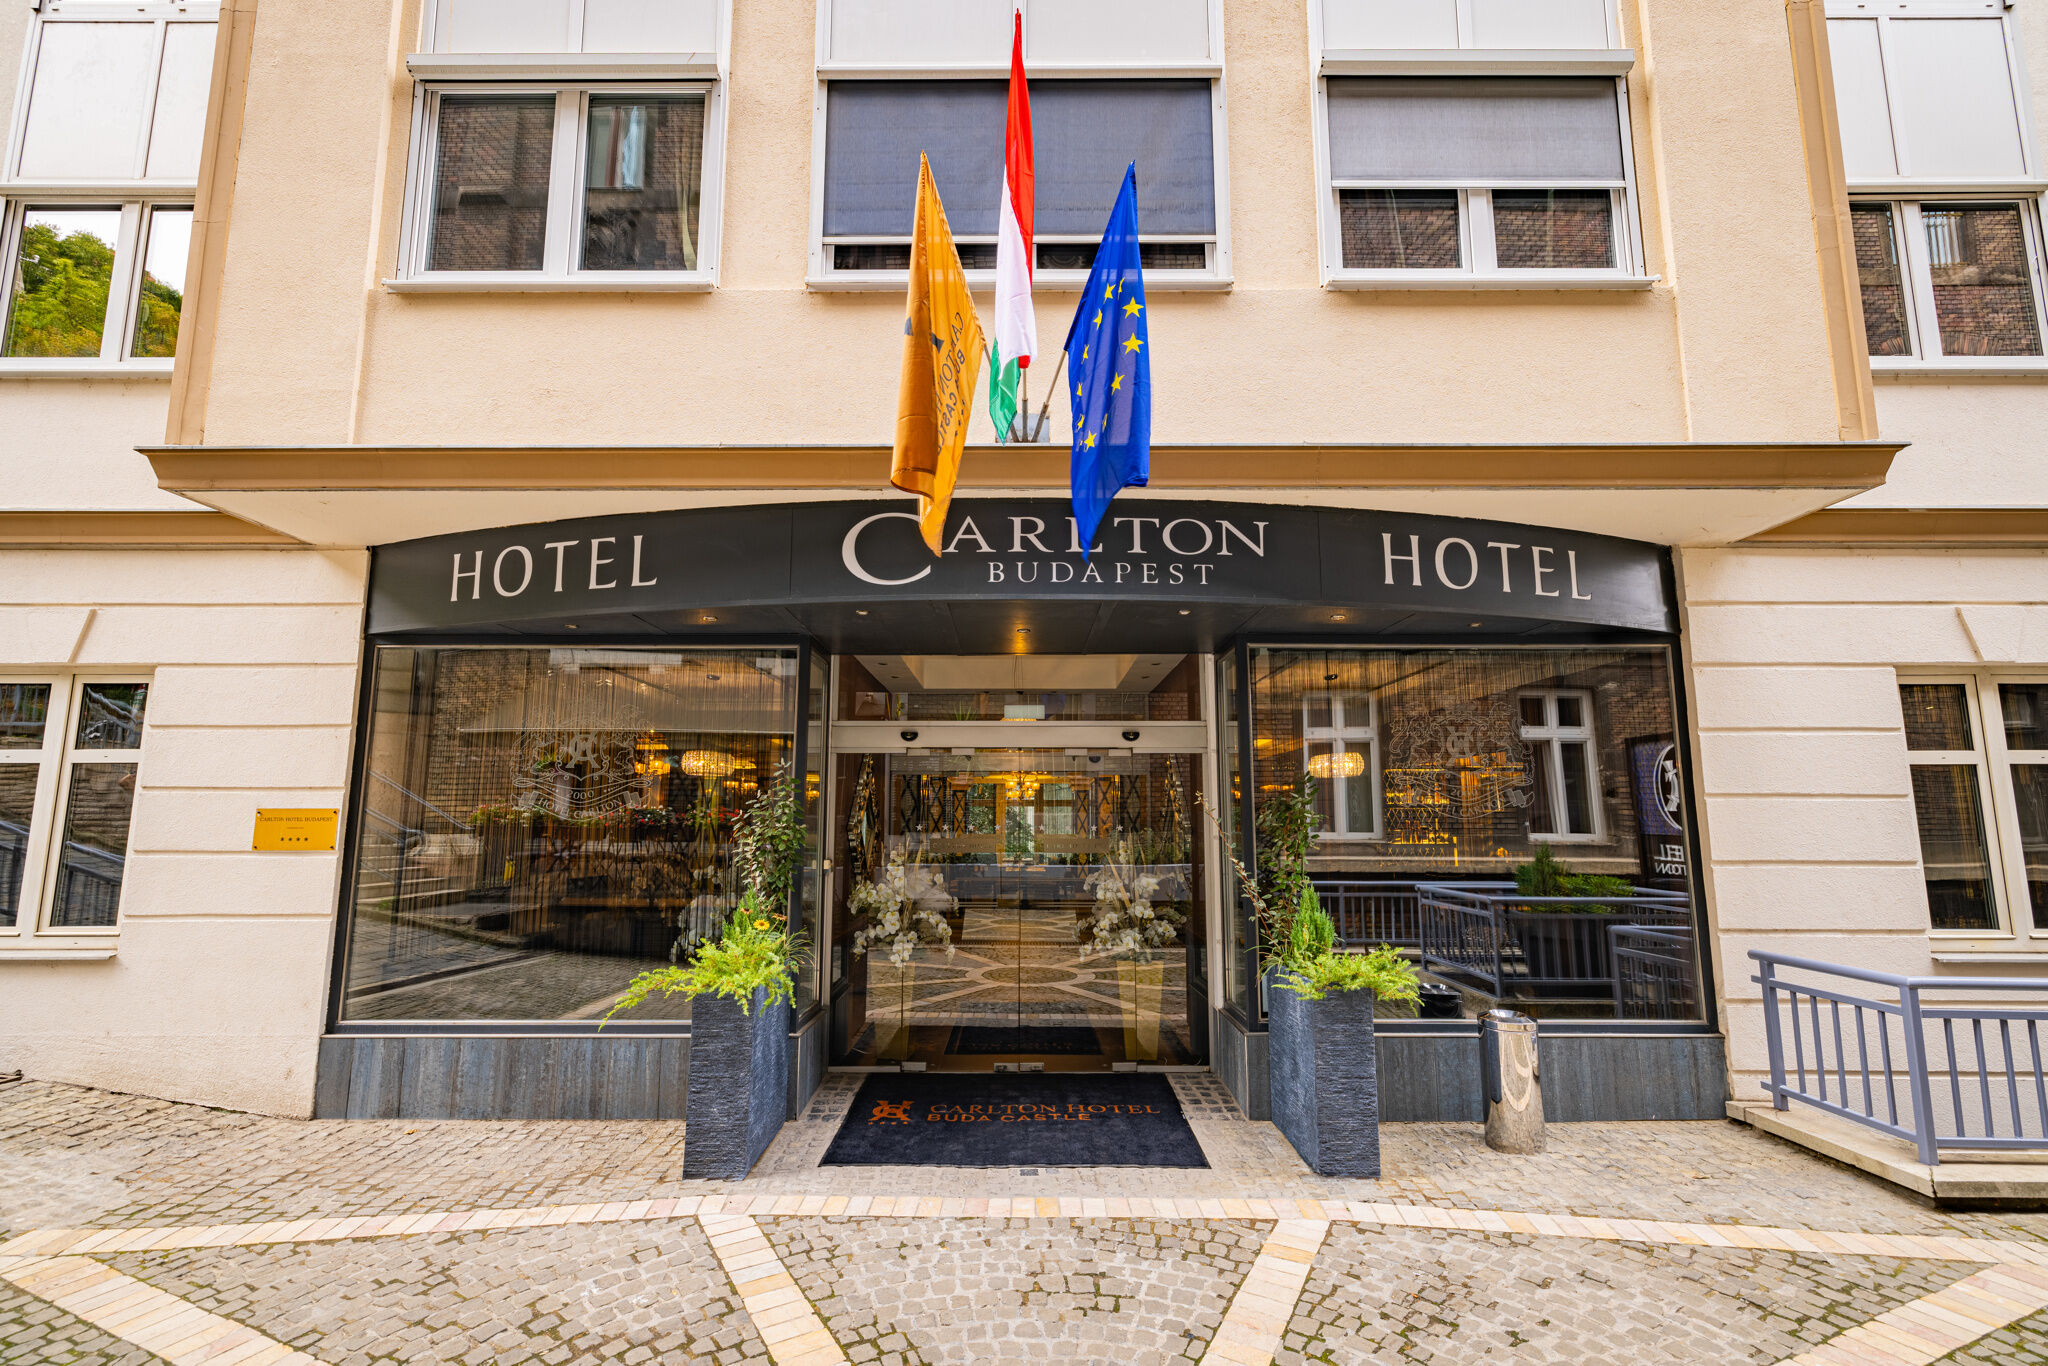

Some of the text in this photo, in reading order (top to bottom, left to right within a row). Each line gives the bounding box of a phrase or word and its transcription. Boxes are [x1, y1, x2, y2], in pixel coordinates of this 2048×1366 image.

[841, 512, 1270, 586] CARLTON
[450, 535, 658, 602] HOTEL
[987, 561, 1214, 585] BUDAPEST
[1381, 532, 1592, 601] HOTEL
[567, 789, 595, 800] 2000
[926, 1112, 1092, 1122] BUDA CASTLE
[930, 1103, 1161, 1115] CARLTON HOTEL
